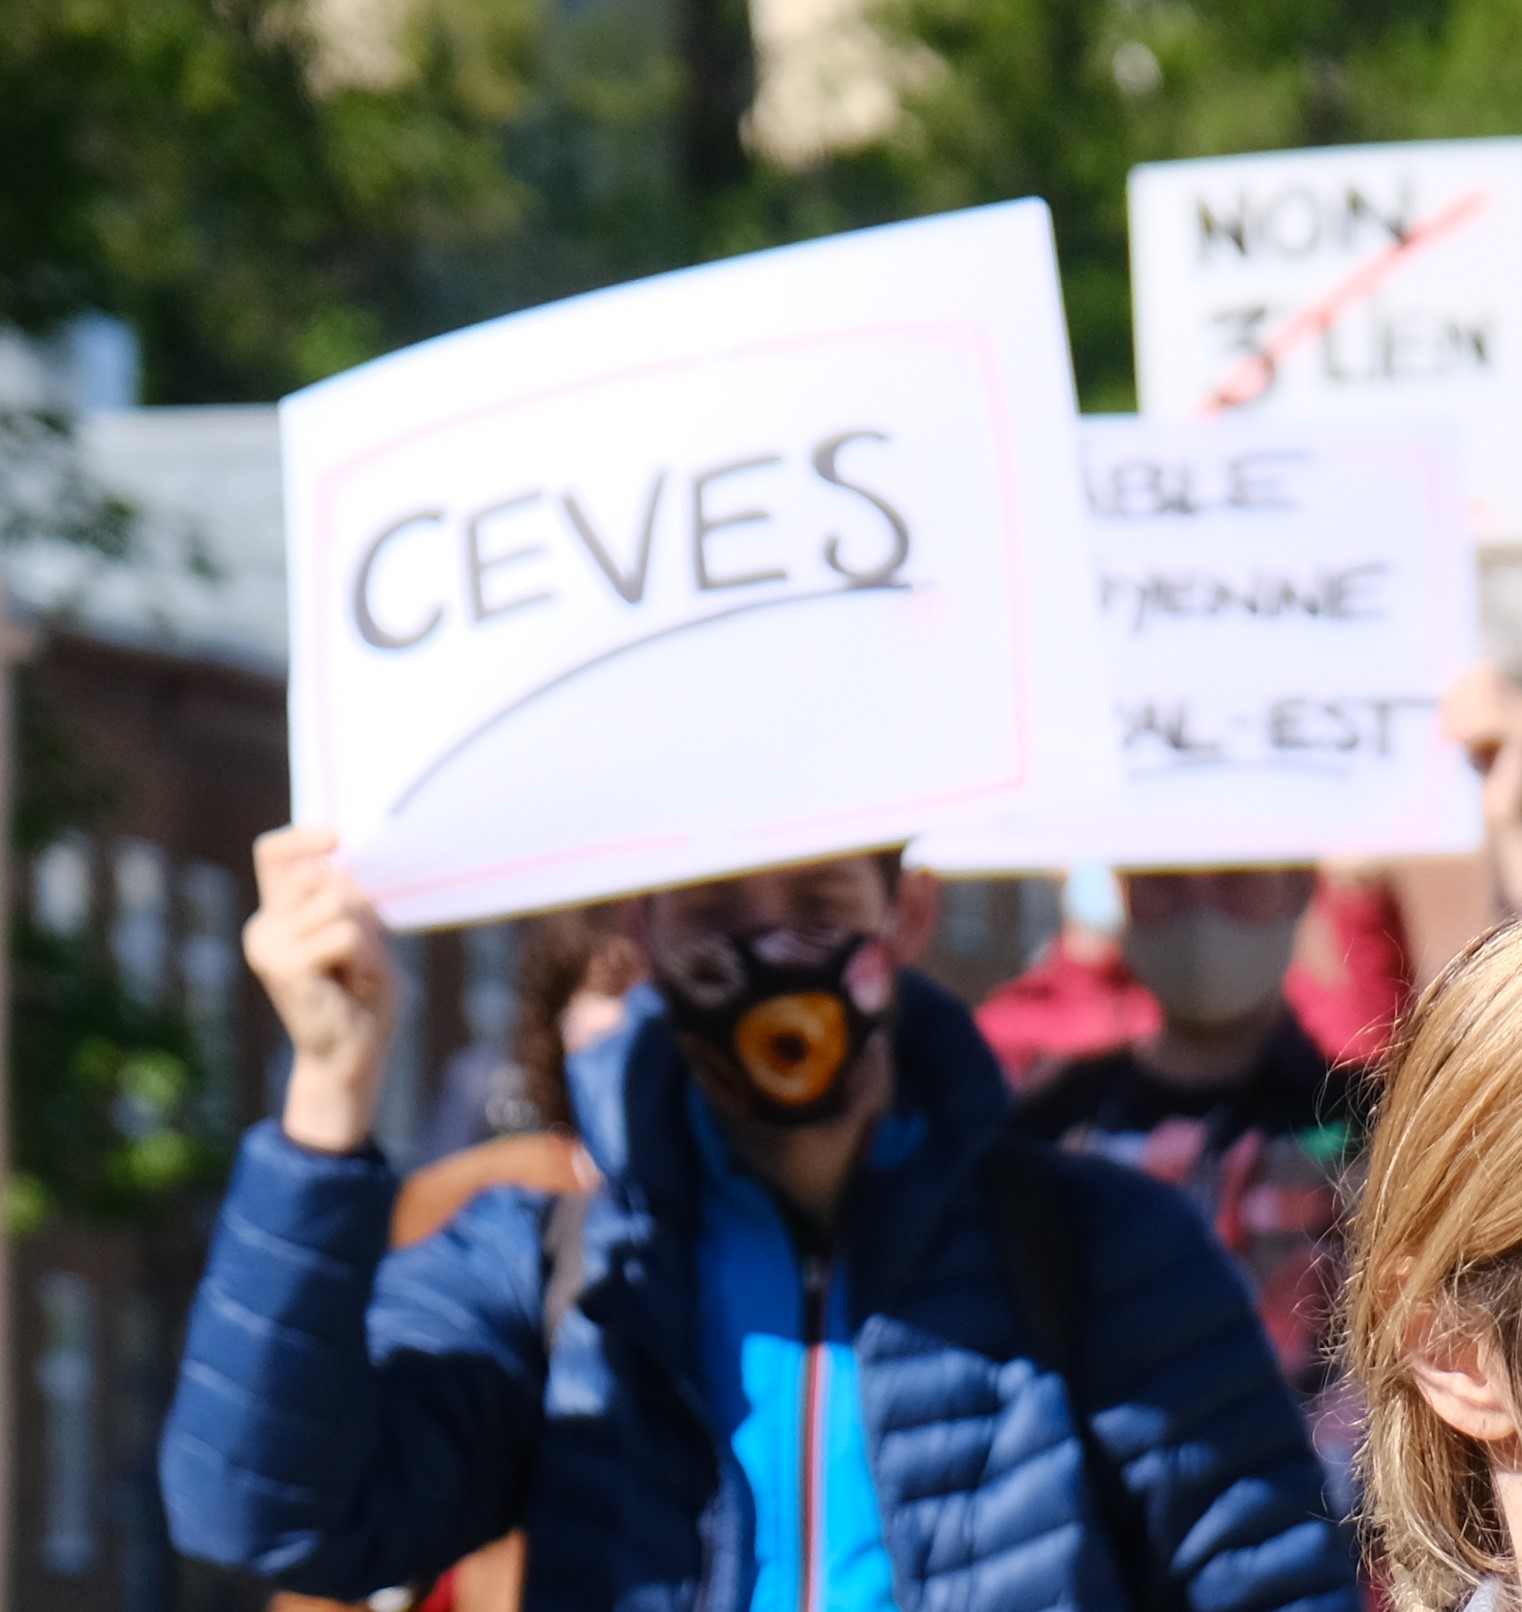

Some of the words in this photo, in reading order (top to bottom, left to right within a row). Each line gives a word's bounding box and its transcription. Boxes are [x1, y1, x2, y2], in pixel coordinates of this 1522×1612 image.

[1197, 180, 1416, 260] NON
[1085, 446, 1310, 518] BLE
[352, 428, 912, 652] CEVES
